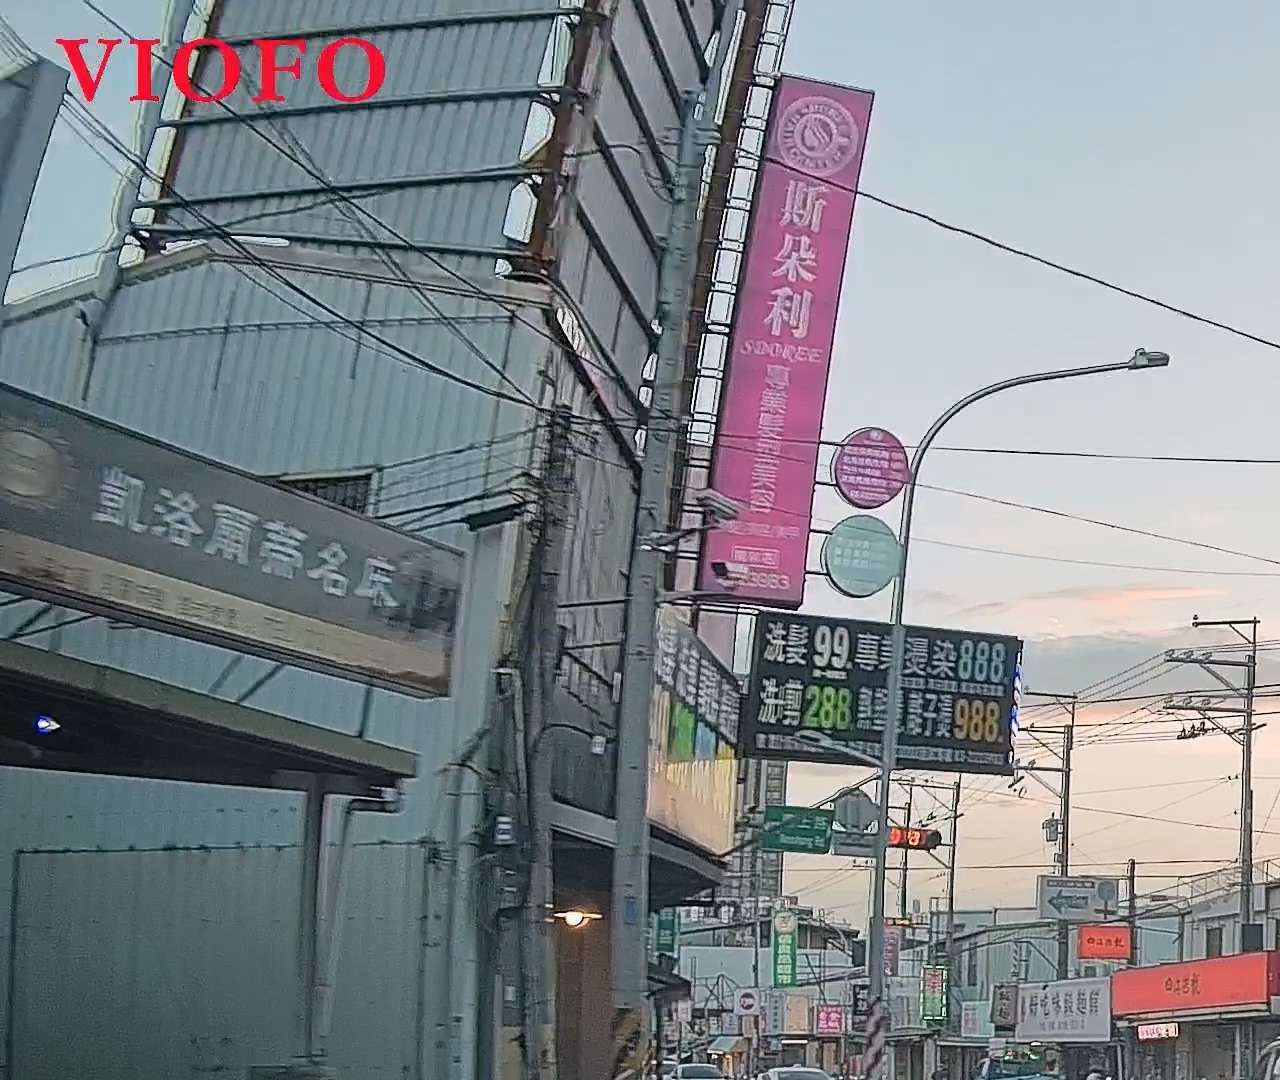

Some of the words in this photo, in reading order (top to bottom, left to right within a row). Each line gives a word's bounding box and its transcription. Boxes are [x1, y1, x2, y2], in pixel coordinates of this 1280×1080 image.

[764, 180, 830, 339] 斯朵利
[801, 685, 851, 730] 288
[953, 698, 1001, 742] 988
